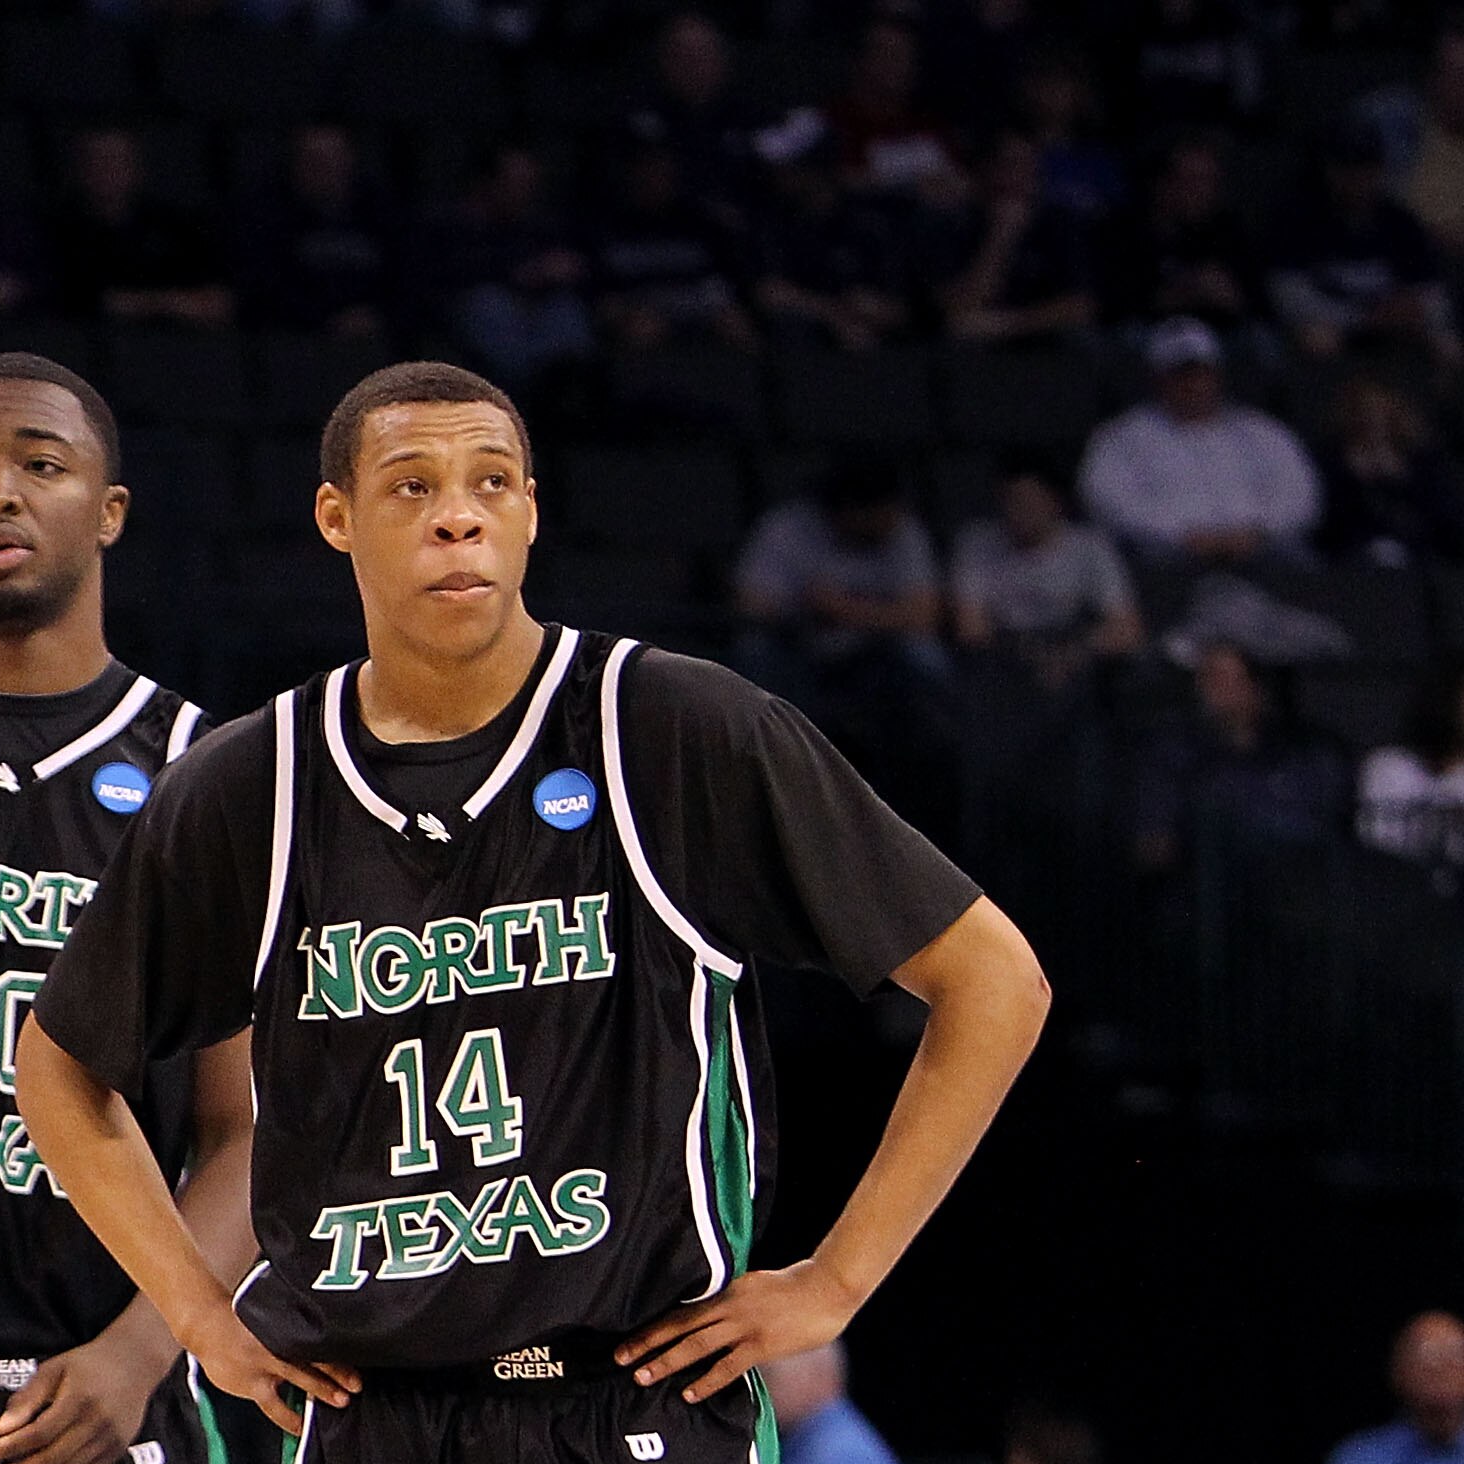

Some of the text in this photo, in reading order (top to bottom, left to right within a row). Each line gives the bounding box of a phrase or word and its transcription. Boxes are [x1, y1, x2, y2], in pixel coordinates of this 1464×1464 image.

[98, 783, 144, 803] NCAA
[543, 794, 589, 815] NCAA
[296, 891, 615, 1021] NORTH
[384, 1028, 522, 1177] 14
[310, 1169, 610, 1291] TEXAS
[493, 1361, 565, 1380] GREEN
